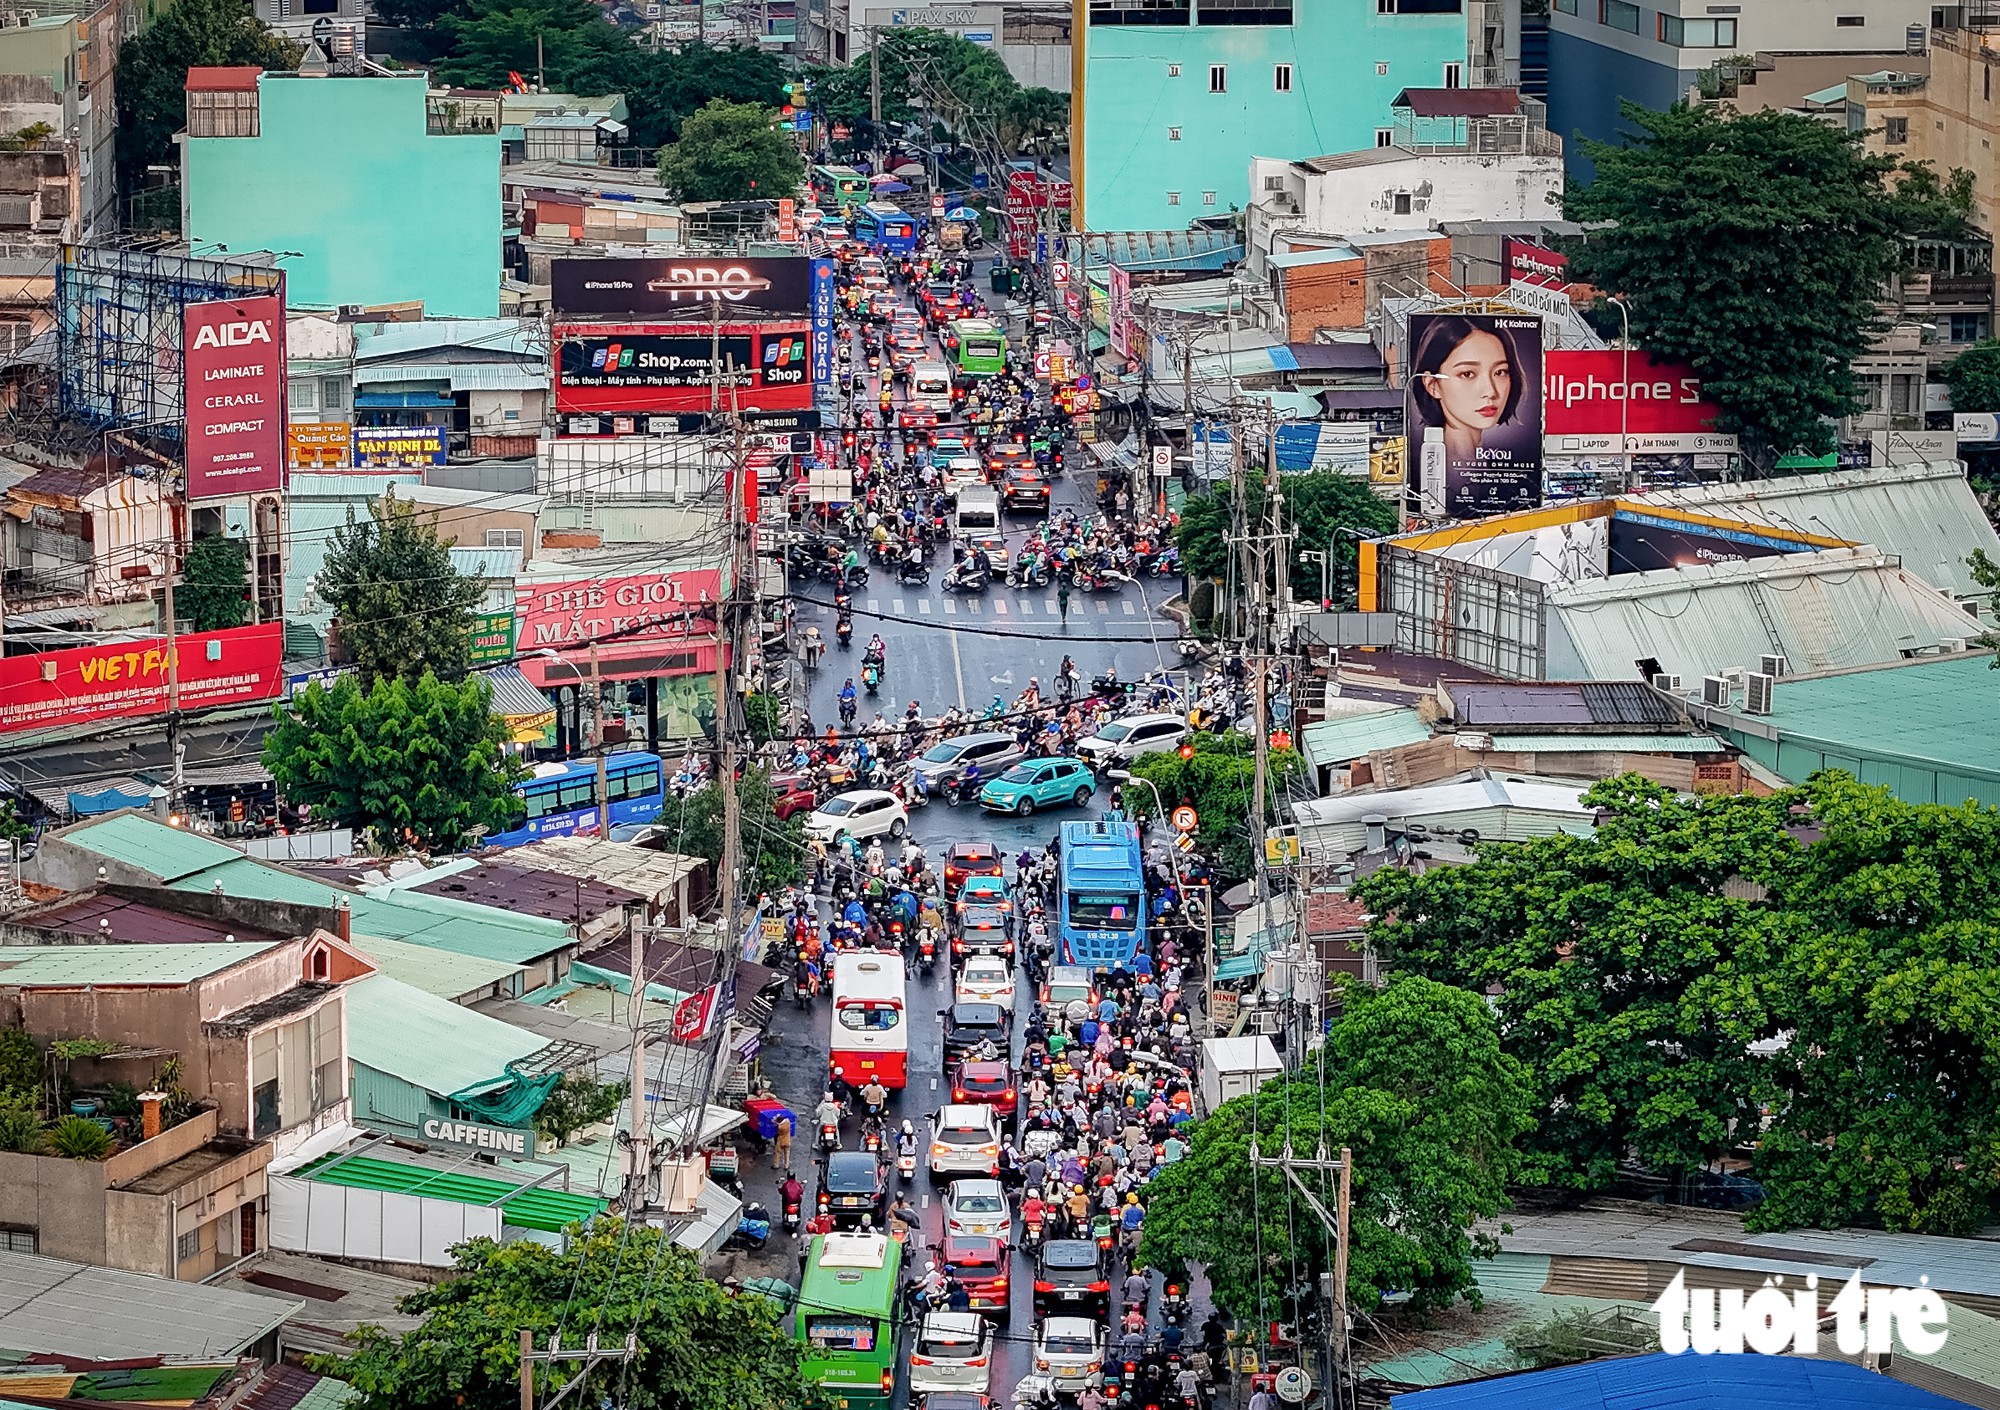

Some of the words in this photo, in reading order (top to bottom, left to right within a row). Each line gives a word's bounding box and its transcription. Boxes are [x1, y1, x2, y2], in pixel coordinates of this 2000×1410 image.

[910, 10, 942, 24] PAX
[945, 9, 978, 24] SKY
[591, 281, 612, 290] iPhone
[621, 281, 633, 289] Pro
[670, 267, 751, 302] PRO
[817, 281, 829, 328] LONG
[1508, 319, 1539, 329] Kolmar
[193, 320, 272, 350] AICA
[817, 330, 829, 381] CHÂU
[205, 365, 265, 381] LAMINATE
[767, 368, 802, 385] Shop
[205, 393, 265, 408] CERARL
[205, 420, 265, 436] COMPACT
[754, 418, 798, 428] SAMSUNG
[297, 432, 328, 443] Quảng
[329, 433, 347, 443] Cáo
[775, 435, 789, 446] 16
[1582, 440, 1610, 448] LAPTOP
[1642, 438, 1654, 447] ÂM
[1654, 439, 1679, 448] THANH
[1709, 439, 1723, 447] THU
[1723, 438, 1734, 447] CŨ
[1915, 438, 1943, 450] Linen
[358, 439, 386, 453] TÂN
[388, 440, 421, 454] ĐỊNH
[423, 439, 441, 451] DL
[1475, 447, 1512, 460] BeYou
[1856, 456, 1869, 464] 53
[539, 579, 607, 613] THẾ
[615, 575, 684, 606] GIỚI
[535, 609, 606, 644] MẮT
[611, 607, 697, 637] KÍNH
[424, 1119, 525, 1154] CAFFEINE
